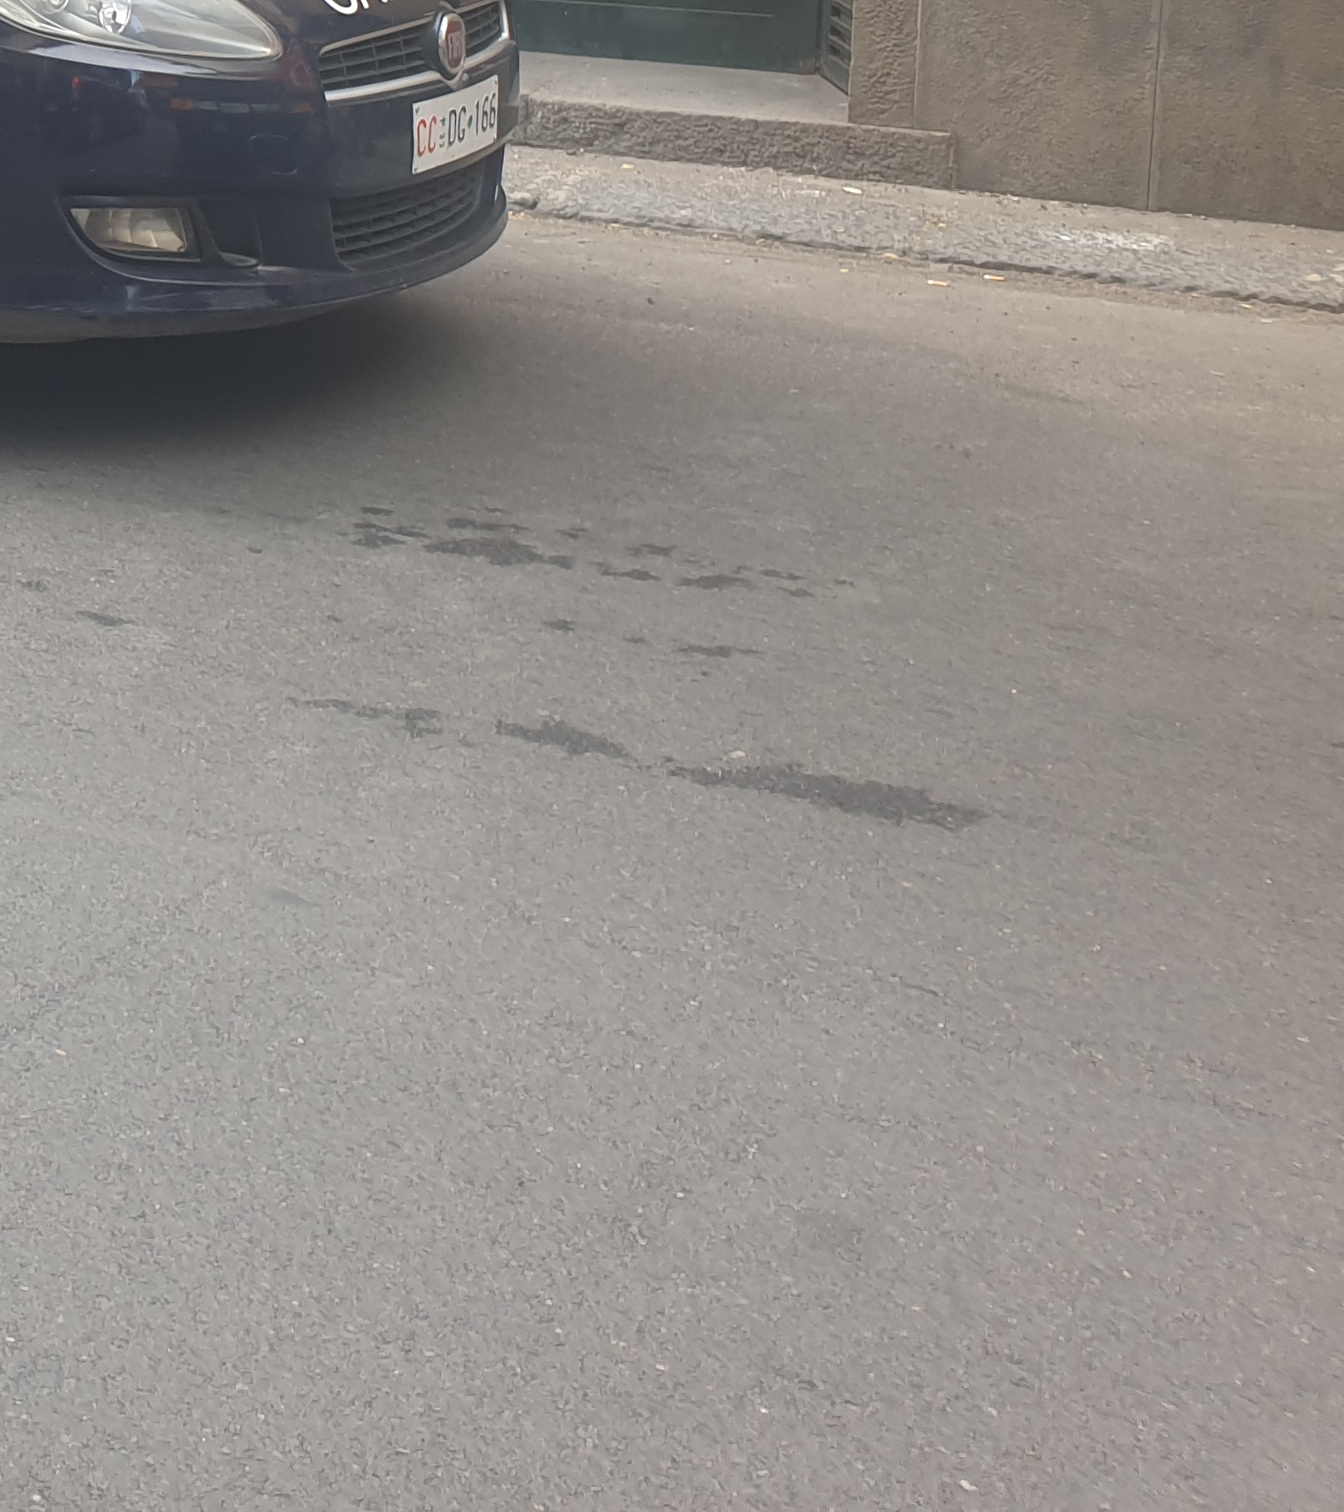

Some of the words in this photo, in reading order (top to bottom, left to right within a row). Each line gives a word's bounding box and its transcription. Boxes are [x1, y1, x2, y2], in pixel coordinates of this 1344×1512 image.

[417, 115, 437, 157] CC
[448, 105, 467, 146] DG
[475, 92, 496, 137] 166
